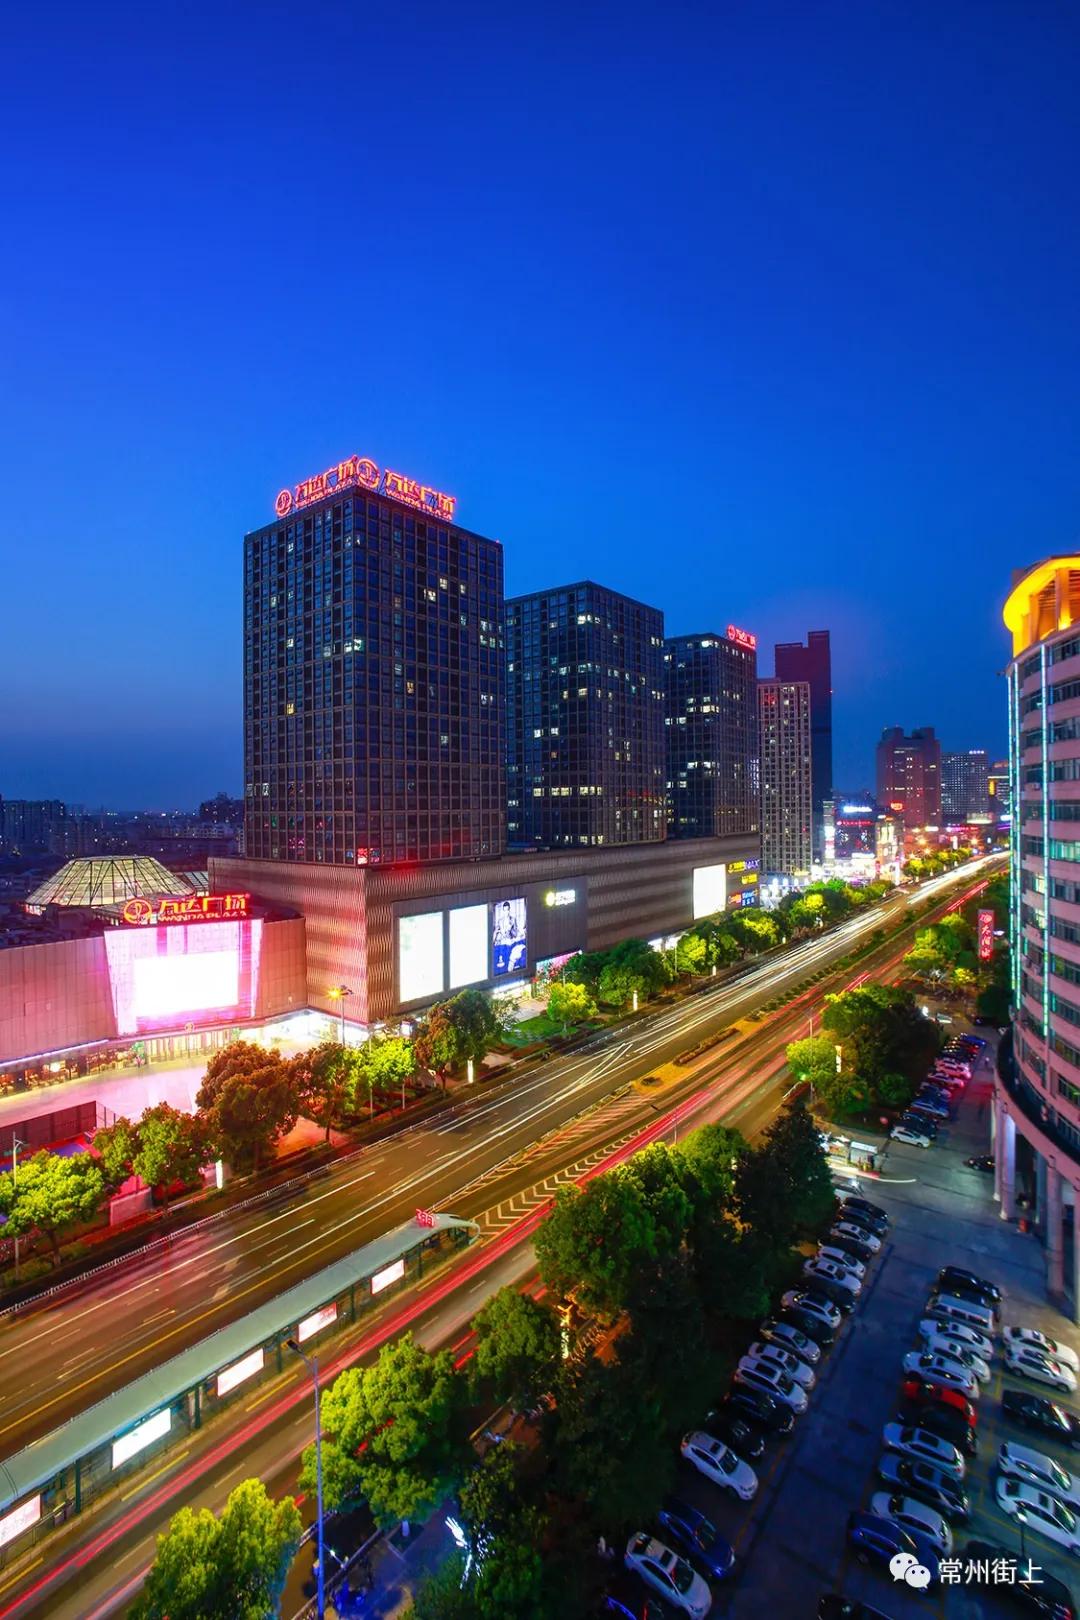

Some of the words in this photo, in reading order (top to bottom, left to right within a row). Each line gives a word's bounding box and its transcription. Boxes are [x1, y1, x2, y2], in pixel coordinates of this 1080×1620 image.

[295, 459, 355, 501] 万达广场
[385, 469, 455, 513] 万达广场
[386, 489, 421, 508] WANDA
[158, 895, 247, 915] 万达广场
[158, 914, 205, 922] WANDA
[206, 911, 247, 919] PLAZA
